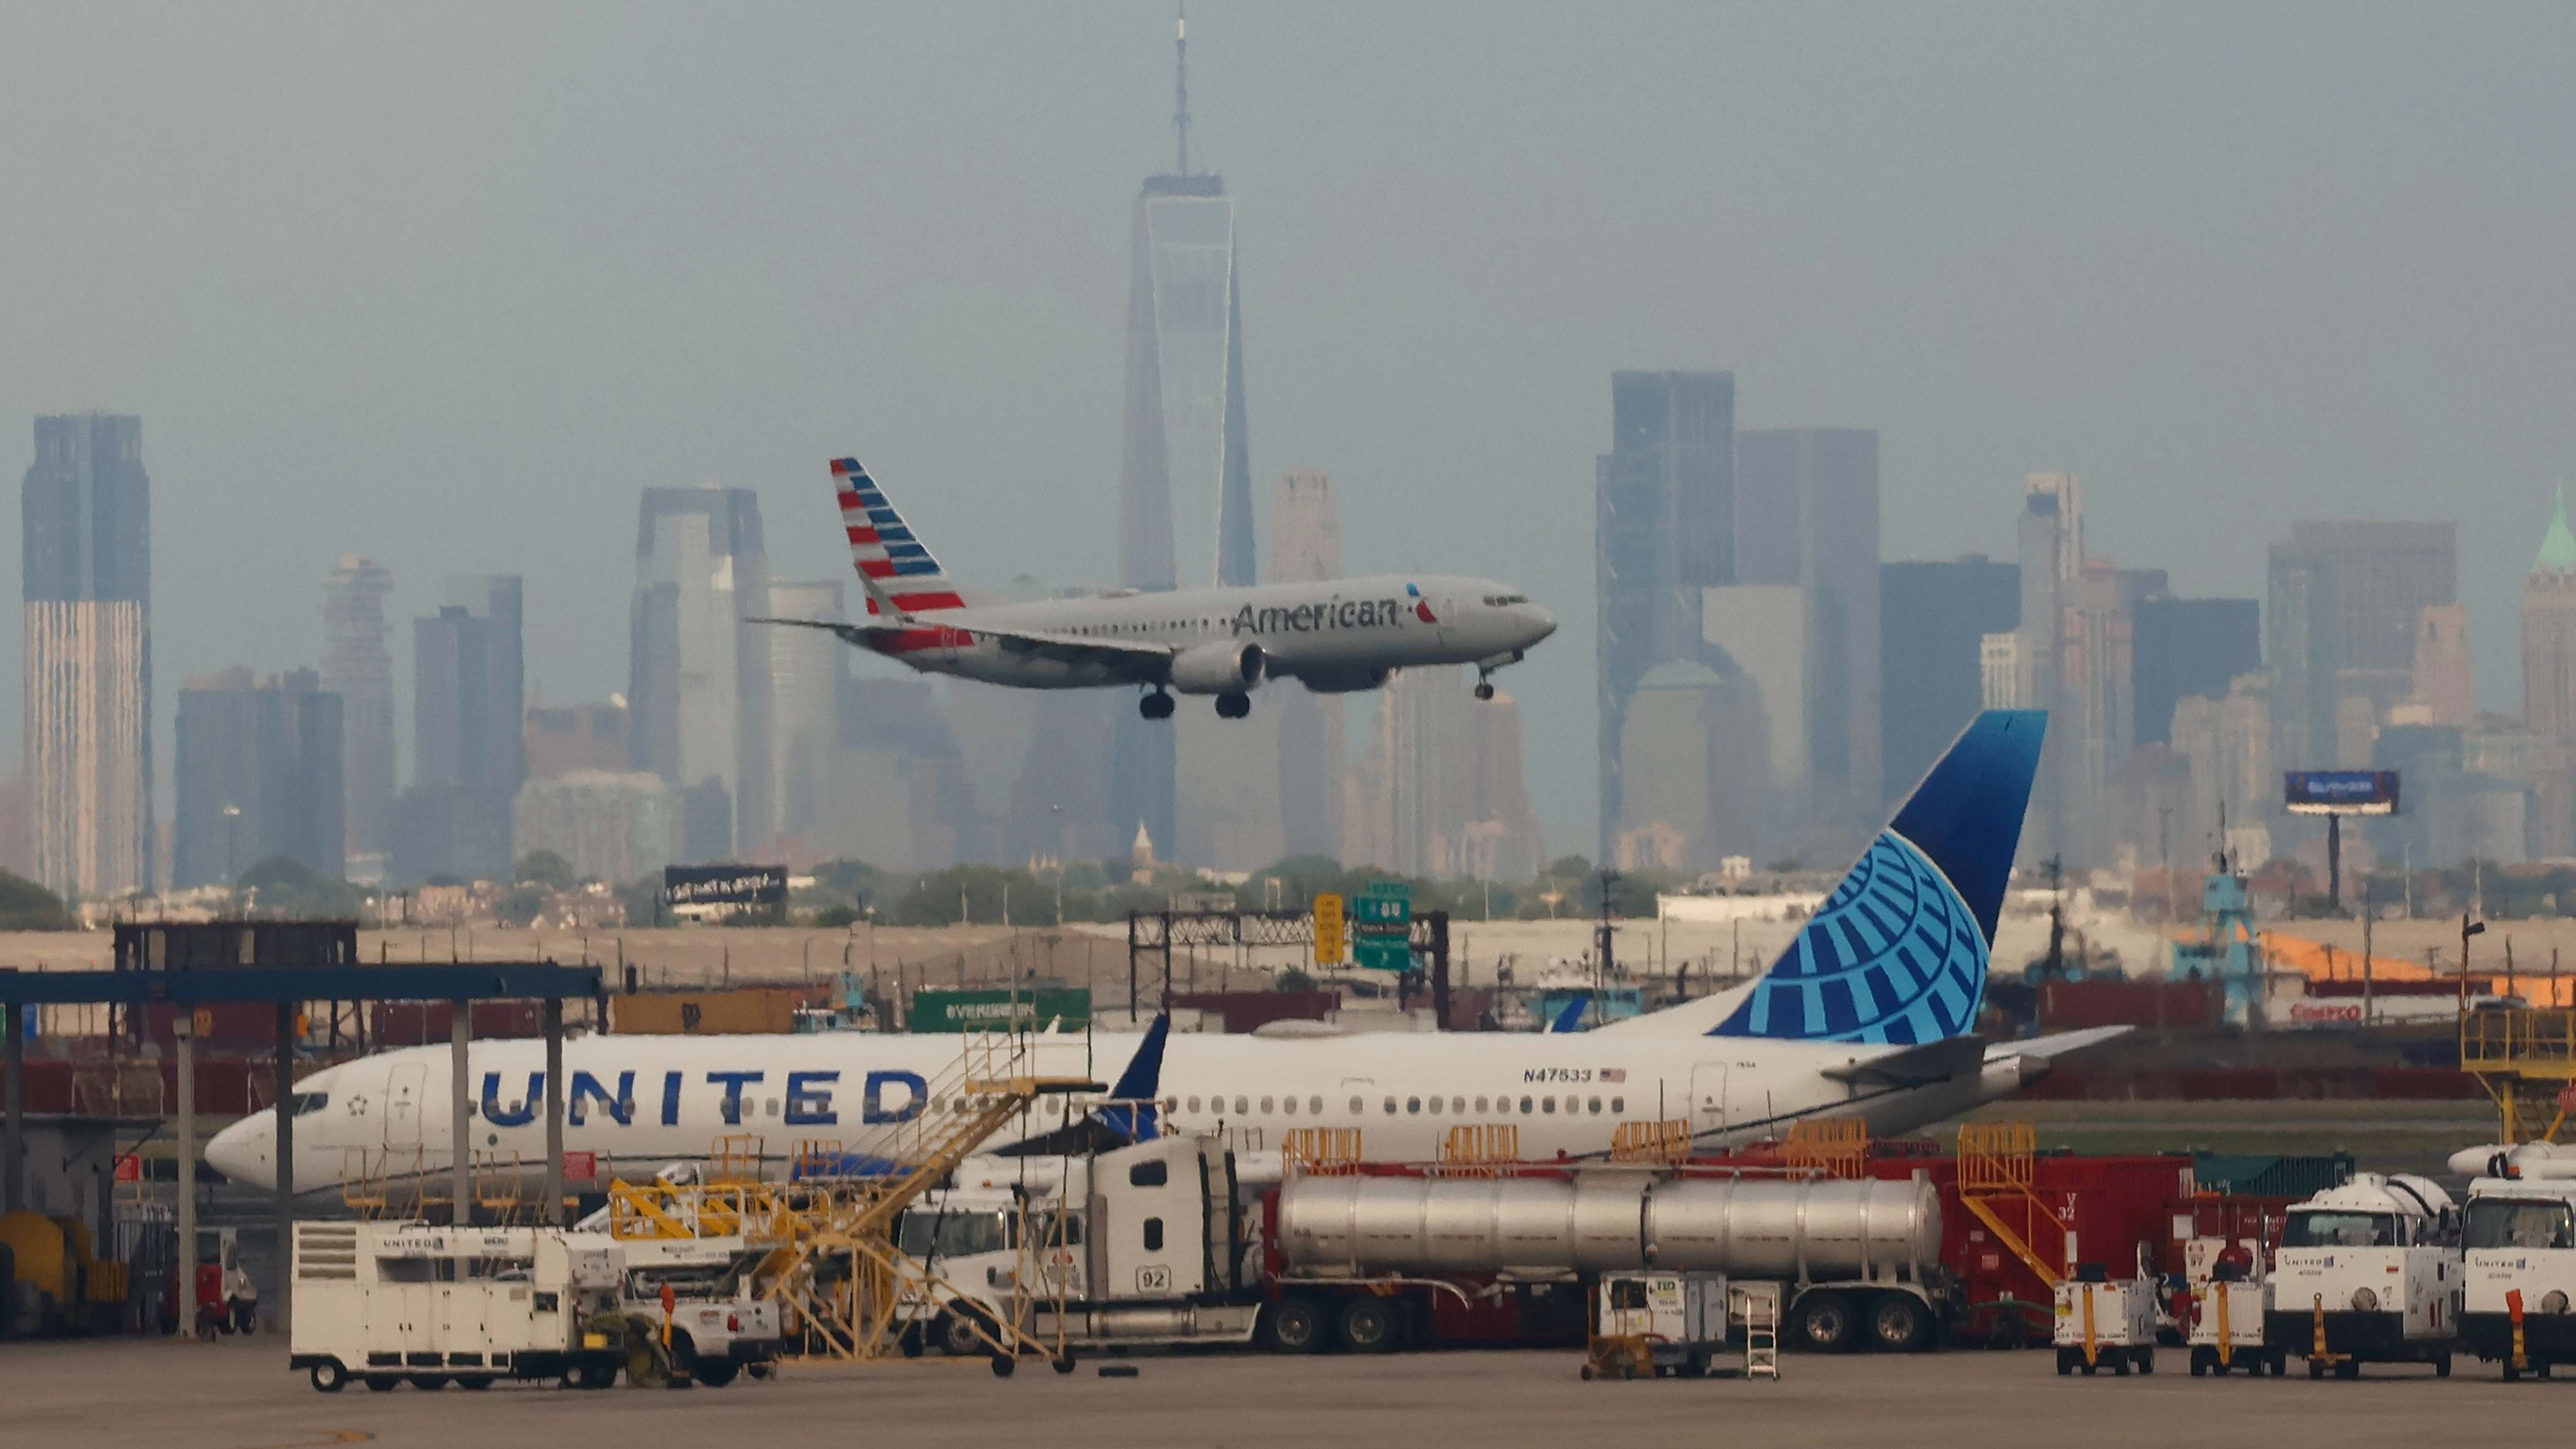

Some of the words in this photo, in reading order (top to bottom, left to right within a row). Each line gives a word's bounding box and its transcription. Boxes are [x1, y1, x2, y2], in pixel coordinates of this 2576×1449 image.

[1231, 594, 1397, 637] American
[480, 1070, 929, 1126] UNITED
[383, 1238, 431, 1248] UNITED
